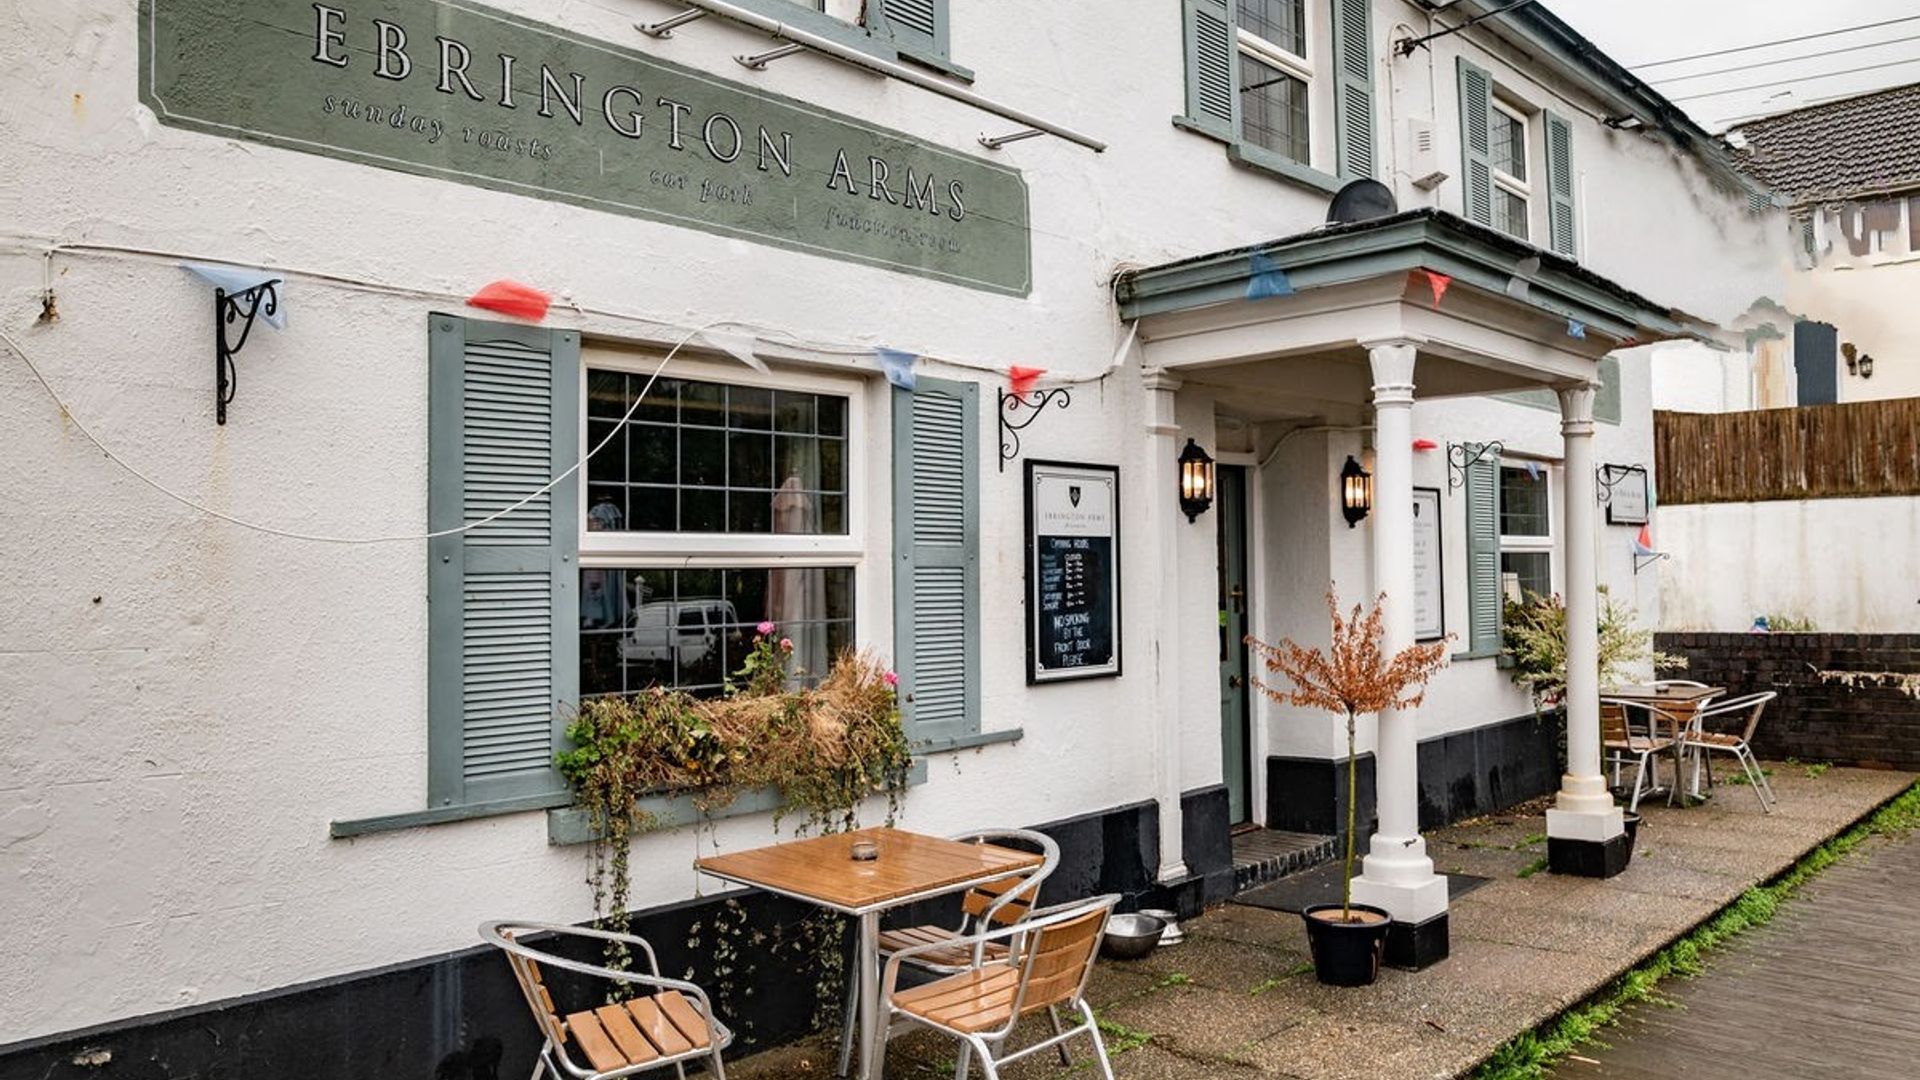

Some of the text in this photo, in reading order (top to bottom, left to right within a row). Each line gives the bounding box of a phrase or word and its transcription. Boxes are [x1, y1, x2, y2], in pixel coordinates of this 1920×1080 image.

[312, 2, 967, 222] EBRINGTON ARMS
[323, 95, 553, 161] sunday roasts
[649, 169, 754, 206] car park
